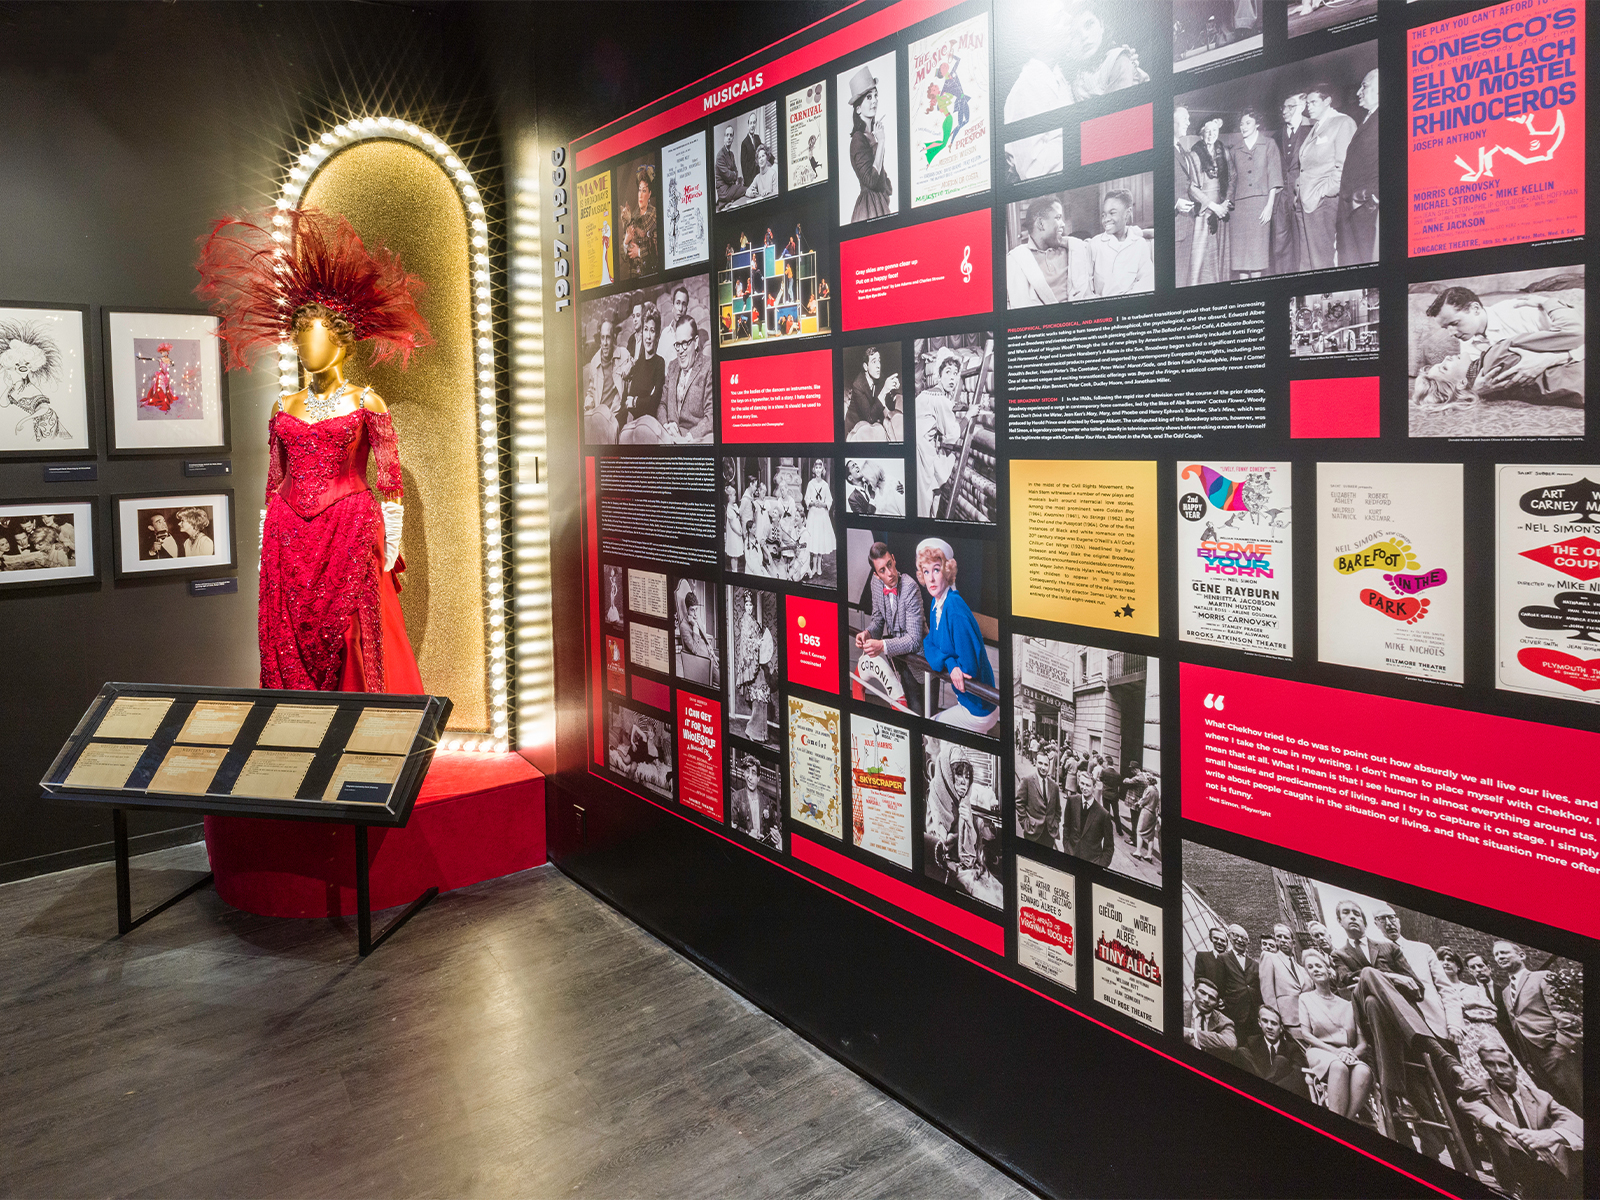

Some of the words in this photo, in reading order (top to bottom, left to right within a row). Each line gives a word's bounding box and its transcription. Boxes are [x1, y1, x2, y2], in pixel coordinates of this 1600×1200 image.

[1412, 28, 1427, 40] THE
[1431, 22, 1450, 36] PLAY
[1453, 16, 1469, 29] YOU
[1472, 9, 1496, 24] CAN'T
[1500, 0, 1533, 16] AFFORD
[1412, 8, 1576, 67] IONESCO'S
[913, 51, 929, 69] THE
[913, 44, 948, 89] MUSIC
[1413, 70, 1444, 93] ELI
[1452, 37, 1575, 83] WALLACH
[703, 72, 764, 111] MUSICALS
[1413, 83, 1470, 111] ZERO
[1479, 58, 1575, 96] MOSTEL
[790, 104, 822, 123] CARNIVAL
[1413, 81, 1576, 137] RHINOCEROS
[956, 127, 986, 150] PRESTON
[1413, 138, 1444, 152] JOSEPH
[1447, 129, 1487, 145] ANTHONY
[552, 147, 566, 222] 1966
[1414, 188, 1445, 201] MORRIS
[1449, 179, 1500, 196] CARNOVSKY
[1414, 198, 1450, 212] MICHAEL
[1452, 194, 1487, 206] STRONG
[1496, 187, 1518, 198] MIKE
[1522, 181, 1554, 194] KELLIN
[1423, 222, 1445, 234] ANNE
[1447, 217, 1485, 231] JACKSON
[1414, 243, 1446, 254] LONGACRE
[1449, 239, 1481, 249] THEATRE,
[555, 239, 570, 312] 1957
[1542, 489, 1565, 498] ART
[1183, 504, 1202, 512] HAPPY
[1530, 500, 1578, 511] CARNEY
[1185, 511, 1201, 519] YEAR
[1525, 523, 1549, 533] NEIL
[1197, 548, 1265, 560] BLOW
[1201, 541, 1272, 555] COME
[1335, 544, 1351, 553] NEIL
[1550, 545, 1578, 556] THE
[1204, 556, 1270, 570] YOUR
[1339, 548, 1400, 572] BAREFOOT
[1205, 563, 1273, 579] HORN
[1399, 577, 1411, 590] IN
[1415, 571, 1440, 590] THE
[1557, 580, 1585, 591] MIKE
[1193, 583, 1220, 593] GENE
[1226, 586, 1279, 600] RAYBURN
[1369, 592, 1407, 616] PARK
[1198, 613, 1225, 621] MORRIS
[1228, 616, 1277, 627] CARNOVSKY
[799, 633, 820, 647] 1963
[1187, 630, 1213, 638] BROOKS
[1217, 635, 1252, 644] ATKINSON
[1256, 640, 1286, 649] THEATRE
[812, 653, 826, 661] Kennedy
[1385, 641, 1405, 651] MIKE
[1410, 645, 1445, 657] NICHOLS
[1386, 658, 1416, 667] BILTMORE
[1419, 662, 1446, 671] THEATRE
[1543, 662, 1586, 674] PLYMOUTH
[861, 660, 892, 695] CORONIA
[688, 708, 700, 718] CAN
[701, 712, 712, 722] GET
[691, 720, 701, 731] FOR
[877, 742, 893, 750] HARRIS
[1205, 732, 1229, 742] where
[1236, 738, 1254, 748] take
[1256, 743, 1270, 751] the
[1273, 747, 1288, 755] cue
[1291, 750, 1299, 758] in
[1302, 753, 1315, 762] my
[1318, 756, 1353, 770] writing.
[1362, 766, 1386, 777] don't
[1205, 718, 1225, 729] What
[1227, 724, 1262, 737] Chekhov
[1264, 731, 1283, 741] tried
[1286, 736, 1295, 744] to
[1298, 738, 1309, 747] do
[1311, 742, 1329, 750] was
[1331, 745, 1341, 753] to
[1343, 748, 1368, 759] point
[1370, 754, 1387, 764] out
[1390, 757, 1411, 768] how
[1414, 764, 1458, 780] absurdly
[1461, 774, 1477, 783] we
[1480, 777, 1493, 786] all
[1497, 780, 1516, 791] live
[1519, 786, 1538, 795] our
[1542, 790, 1571, 803] lives,
[1575, 798, 1598, 809] and
[859, 775, 902, 789] SKYSCRAPER
[1206, 781, 1219, 792] not
[1221, 785, 1227, 793] is
[1229, 787, 1253, 799] funny.
[1221, 798, 1240, 809] Simon,
[1241, 805, 1271, 817] Playwright
[1021, 894, 1039, 908] EDWARD
[1041, 902, 1061, 916] ALBEE'S
[1099, 905, 1122, 922] GIELGUD
[1134, 918, 1156, 936] WORTH
[1047, 929, 1073, 948] WOOLF?
[1100, 944, 1124, 966] TINY
[1127, 956, 1157, 980] ALICE
[1104, 994, 1115, 1005] BILLY
[1118, 1002, 1129, 1011] ROSE
[1131, 1006, 1152, 1022] THEATRE
